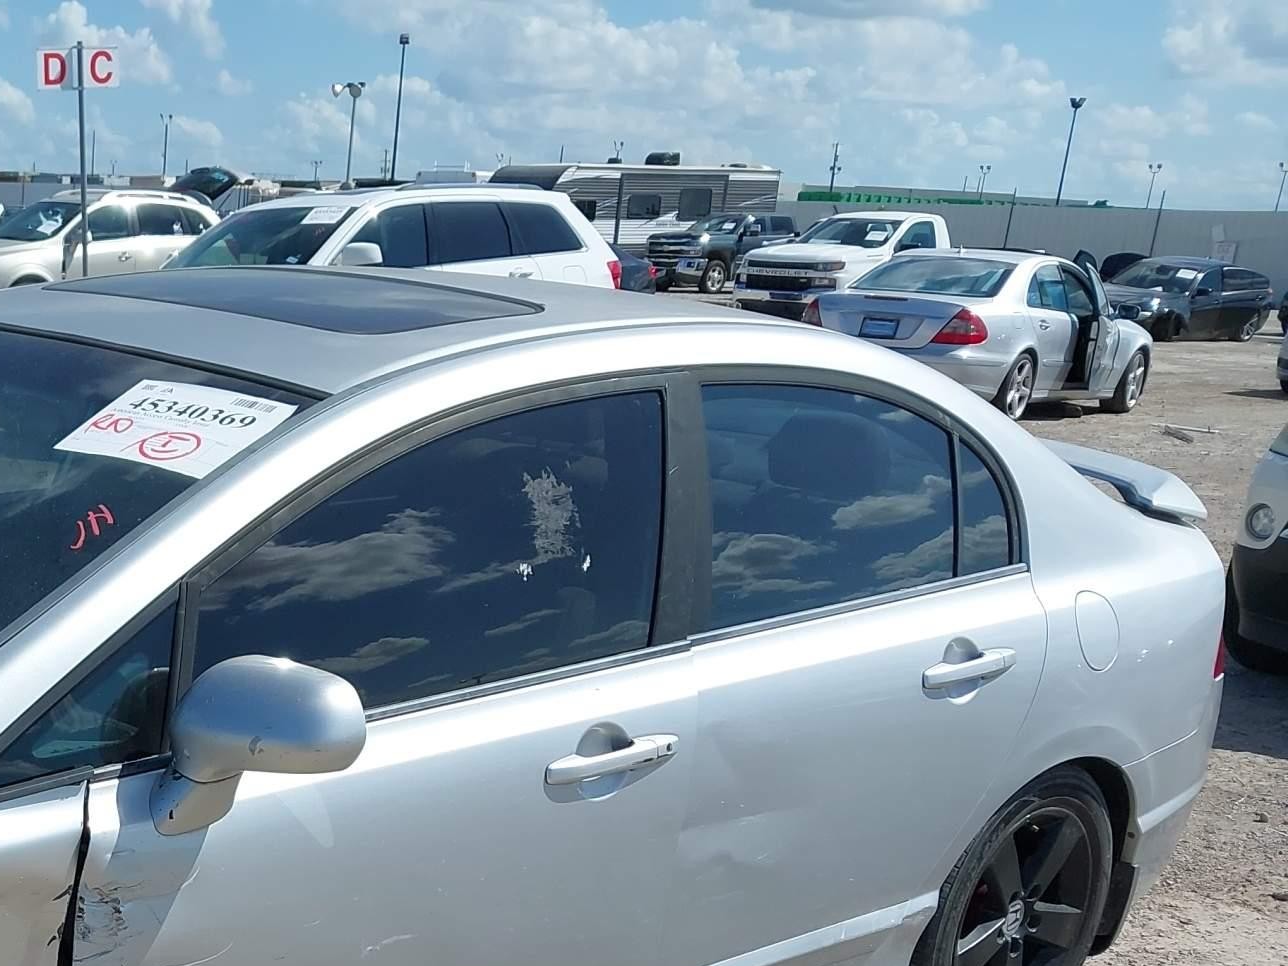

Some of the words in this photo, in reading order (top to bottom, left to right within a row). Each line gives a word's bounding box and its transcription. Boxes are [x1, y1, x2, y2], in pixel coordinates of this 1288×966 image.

[43, 52, 67, 86] D
[90, 50, 113, 85] C
[129, 397, 257, 429] 45340369
